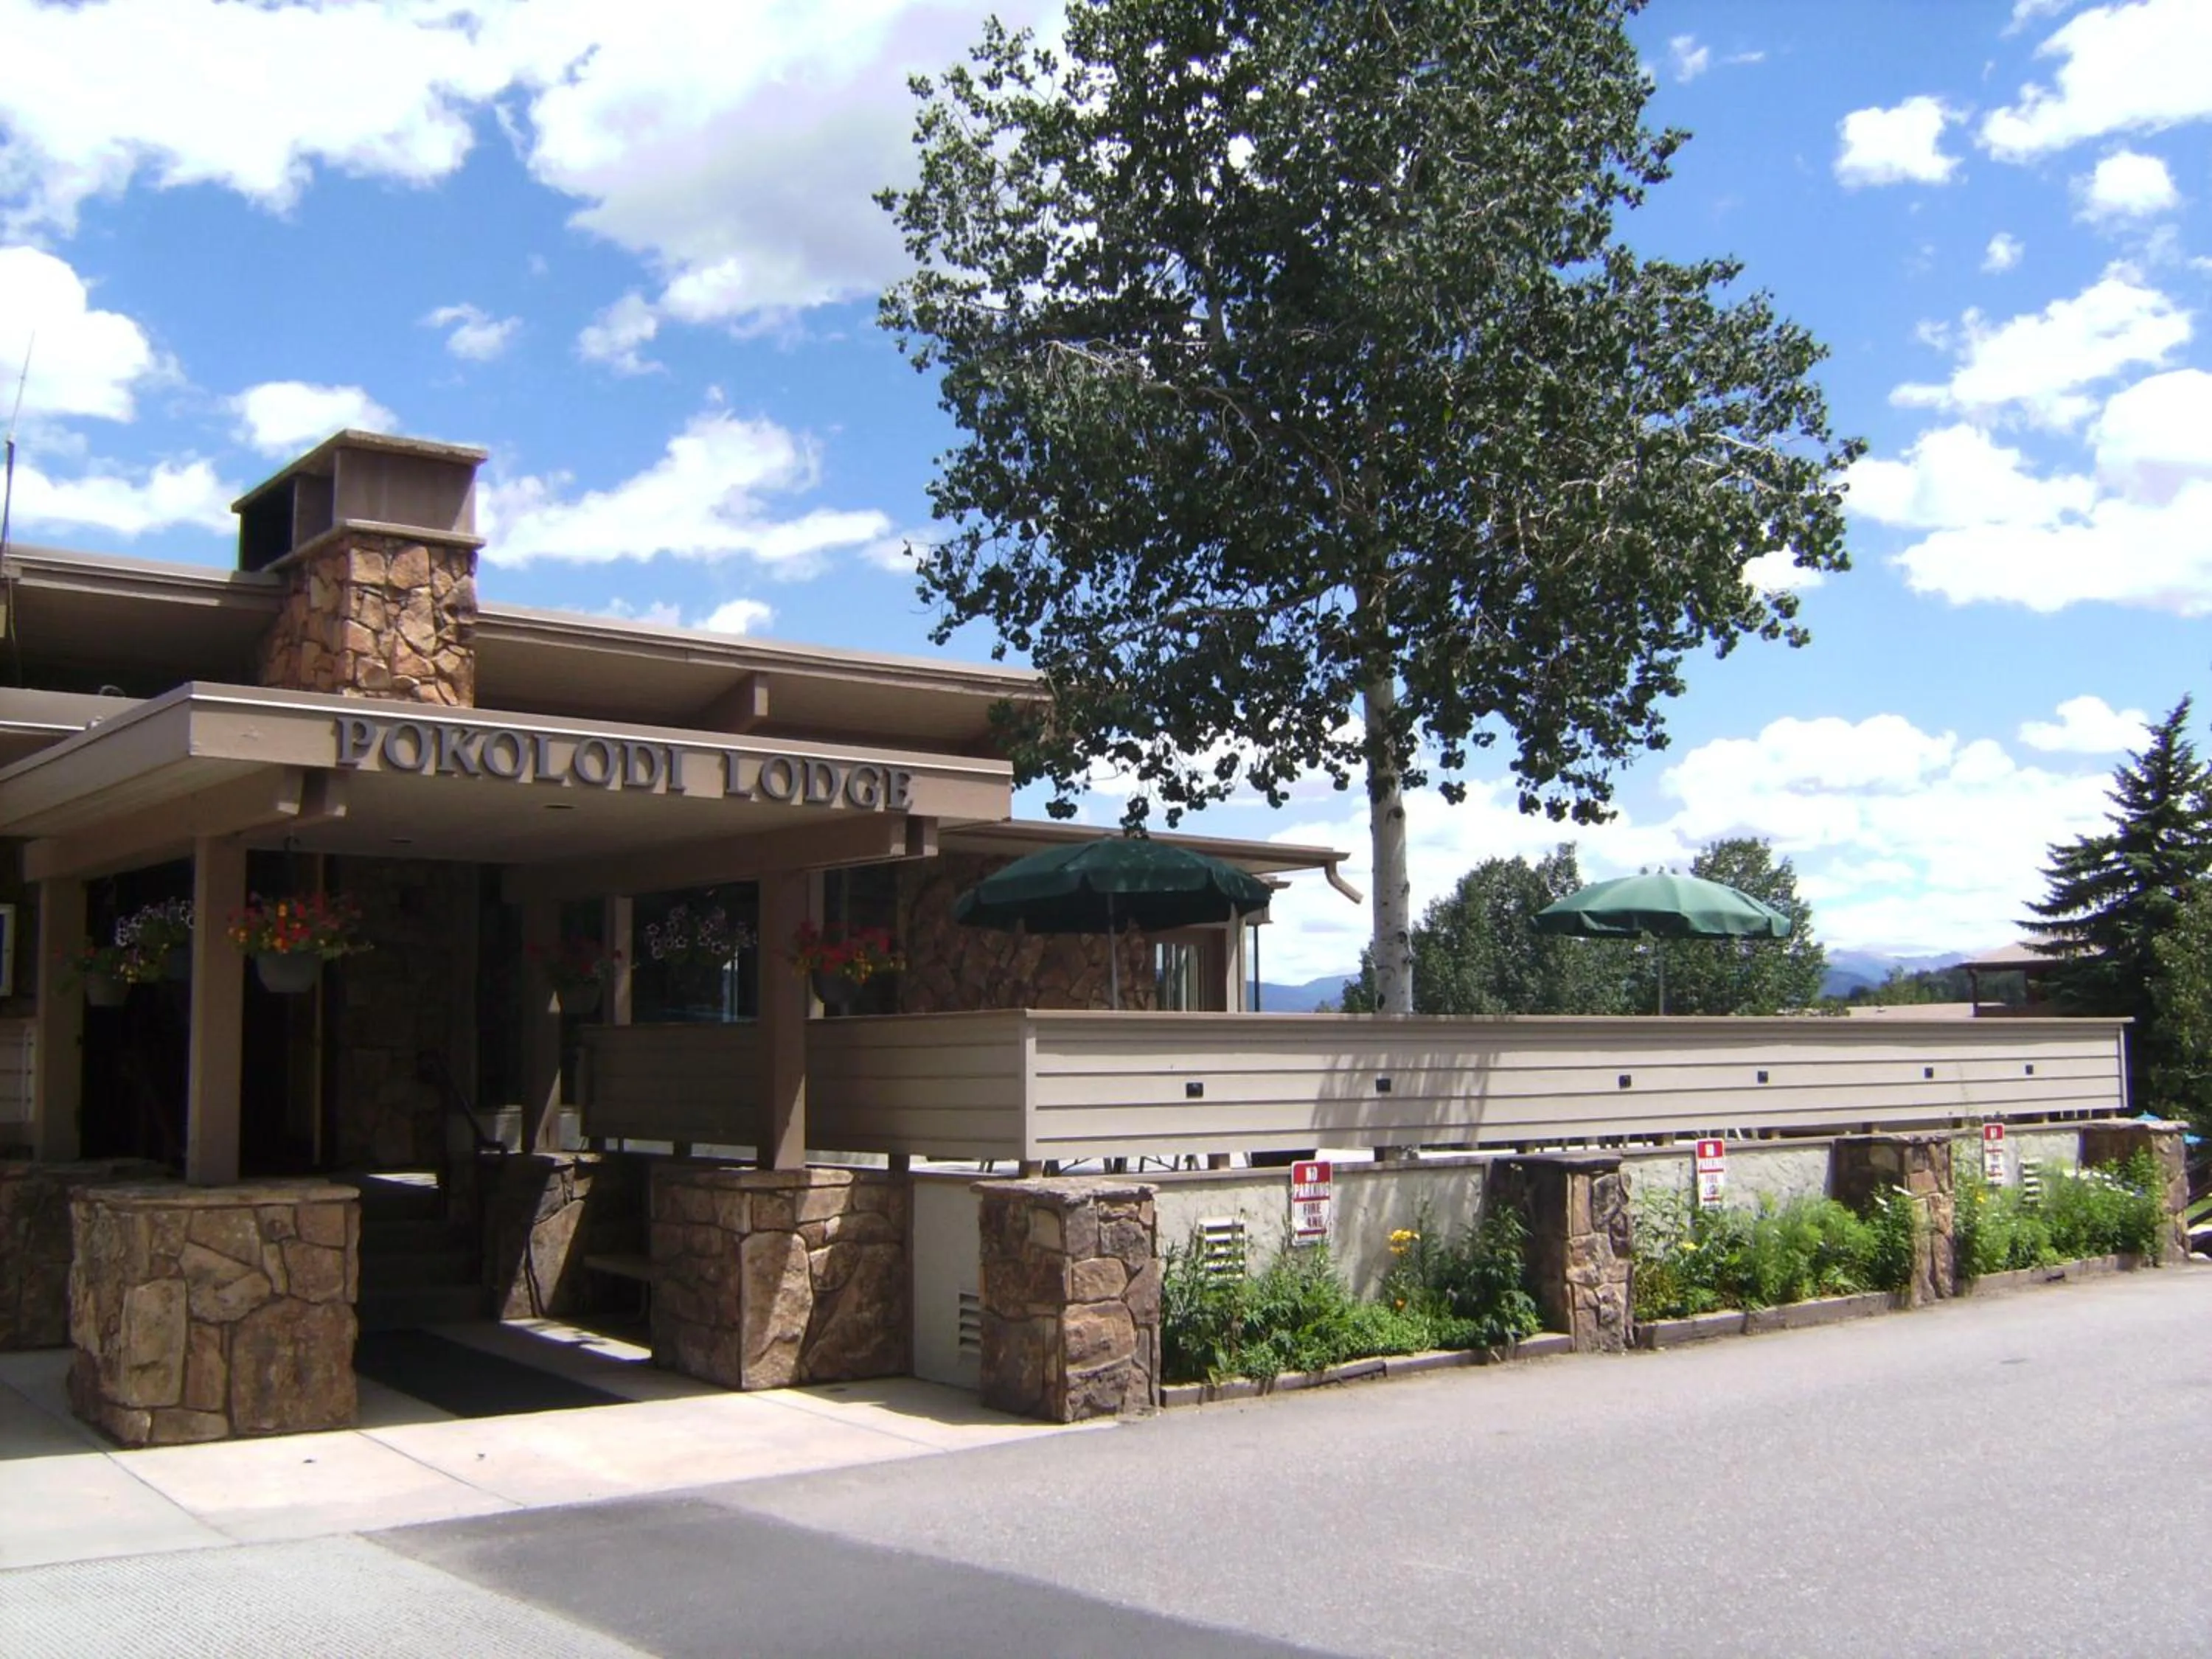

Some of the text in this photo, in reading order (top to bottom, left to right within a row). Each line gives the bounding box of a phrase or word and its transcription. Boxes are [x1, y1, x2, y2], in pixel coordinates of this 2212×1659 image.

[335, 717, 914, 810] POKOLODI LODGE
[1294, 1183, 1329, 1198] PARKING
